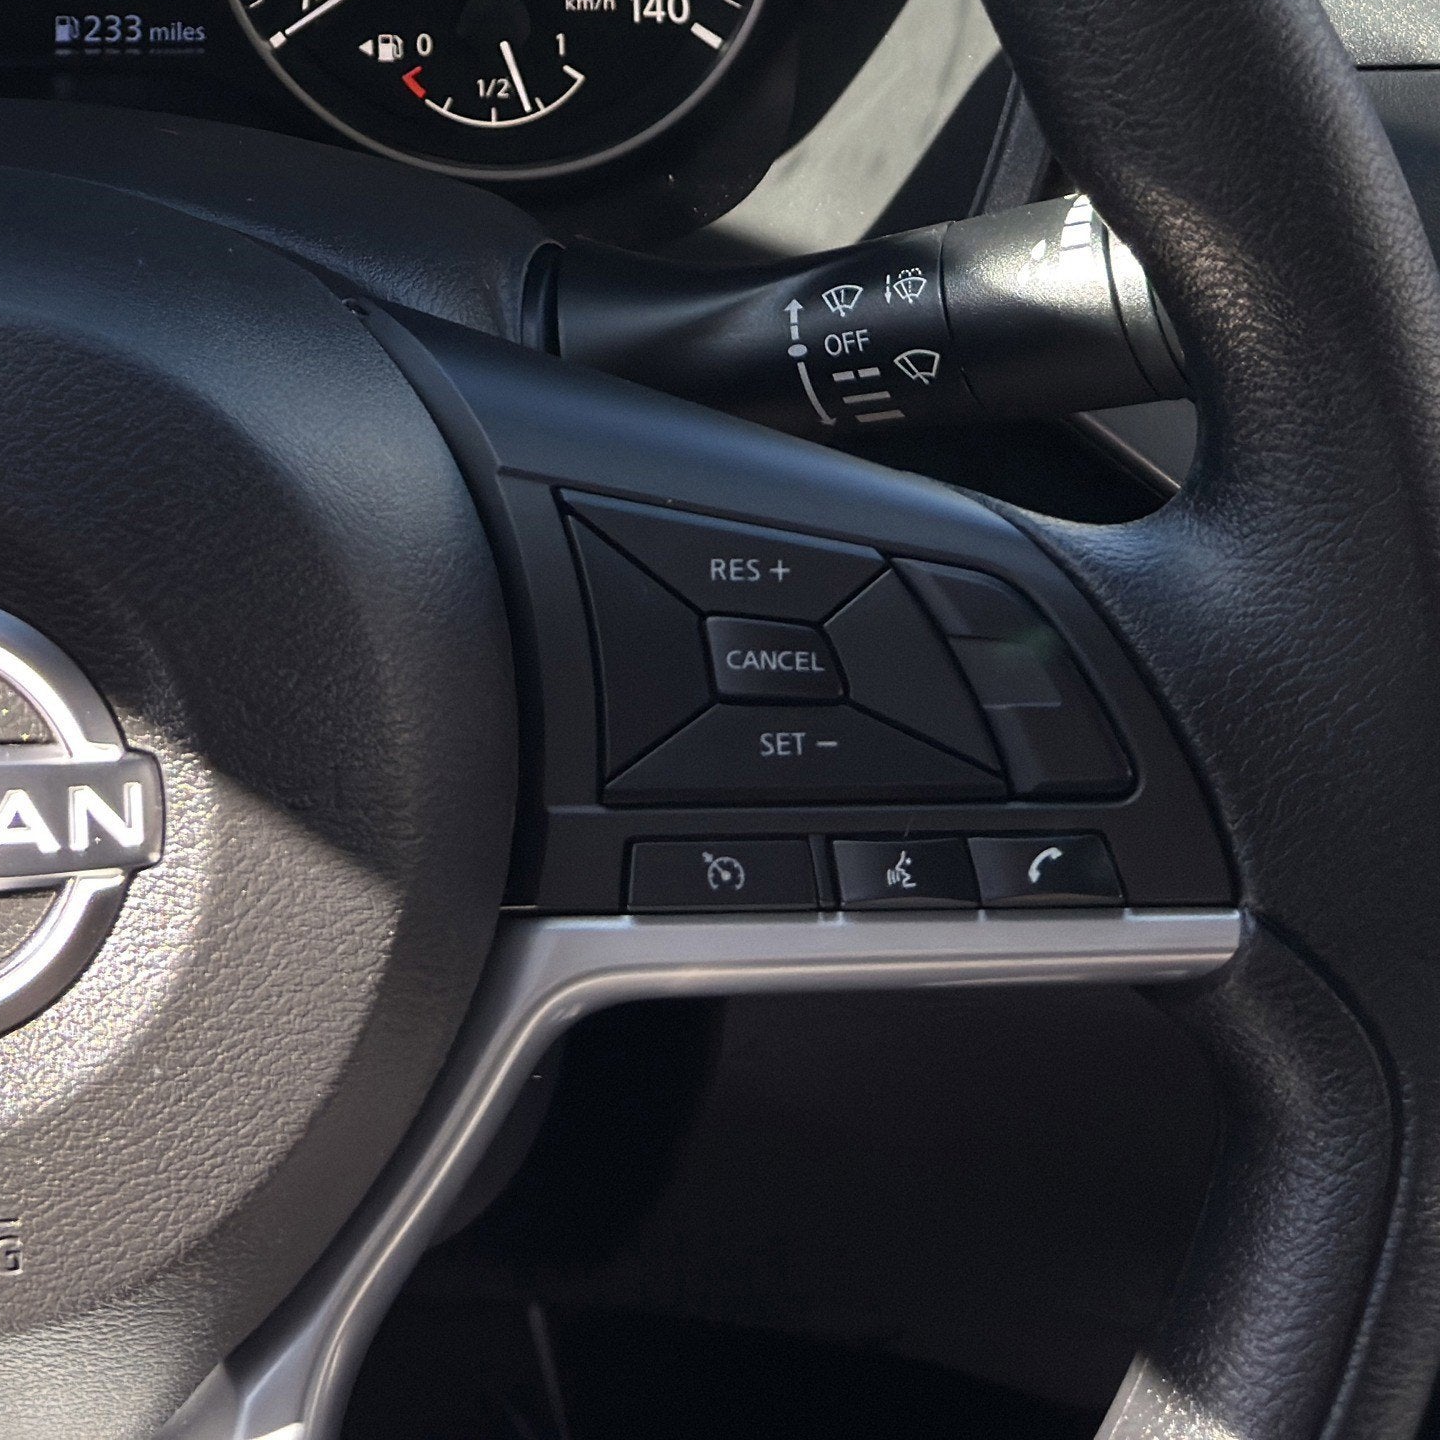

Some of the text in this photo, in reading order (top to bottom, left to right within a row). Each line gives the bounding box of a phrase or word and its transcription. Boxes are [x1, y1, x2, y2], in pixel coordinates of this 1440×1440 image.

[84, 15, 206, 43] 233 miles
[416, 33, 433, 57] 0
[555, 33, 566, 57] 1
[477, 78, 511, 100] 1/2
[824, 329, 870, 357] OFF
[710, 558, 760, 582] RES
[727, 650, 825, 672] CANCEL
[760, 733, 806, 757] SET
